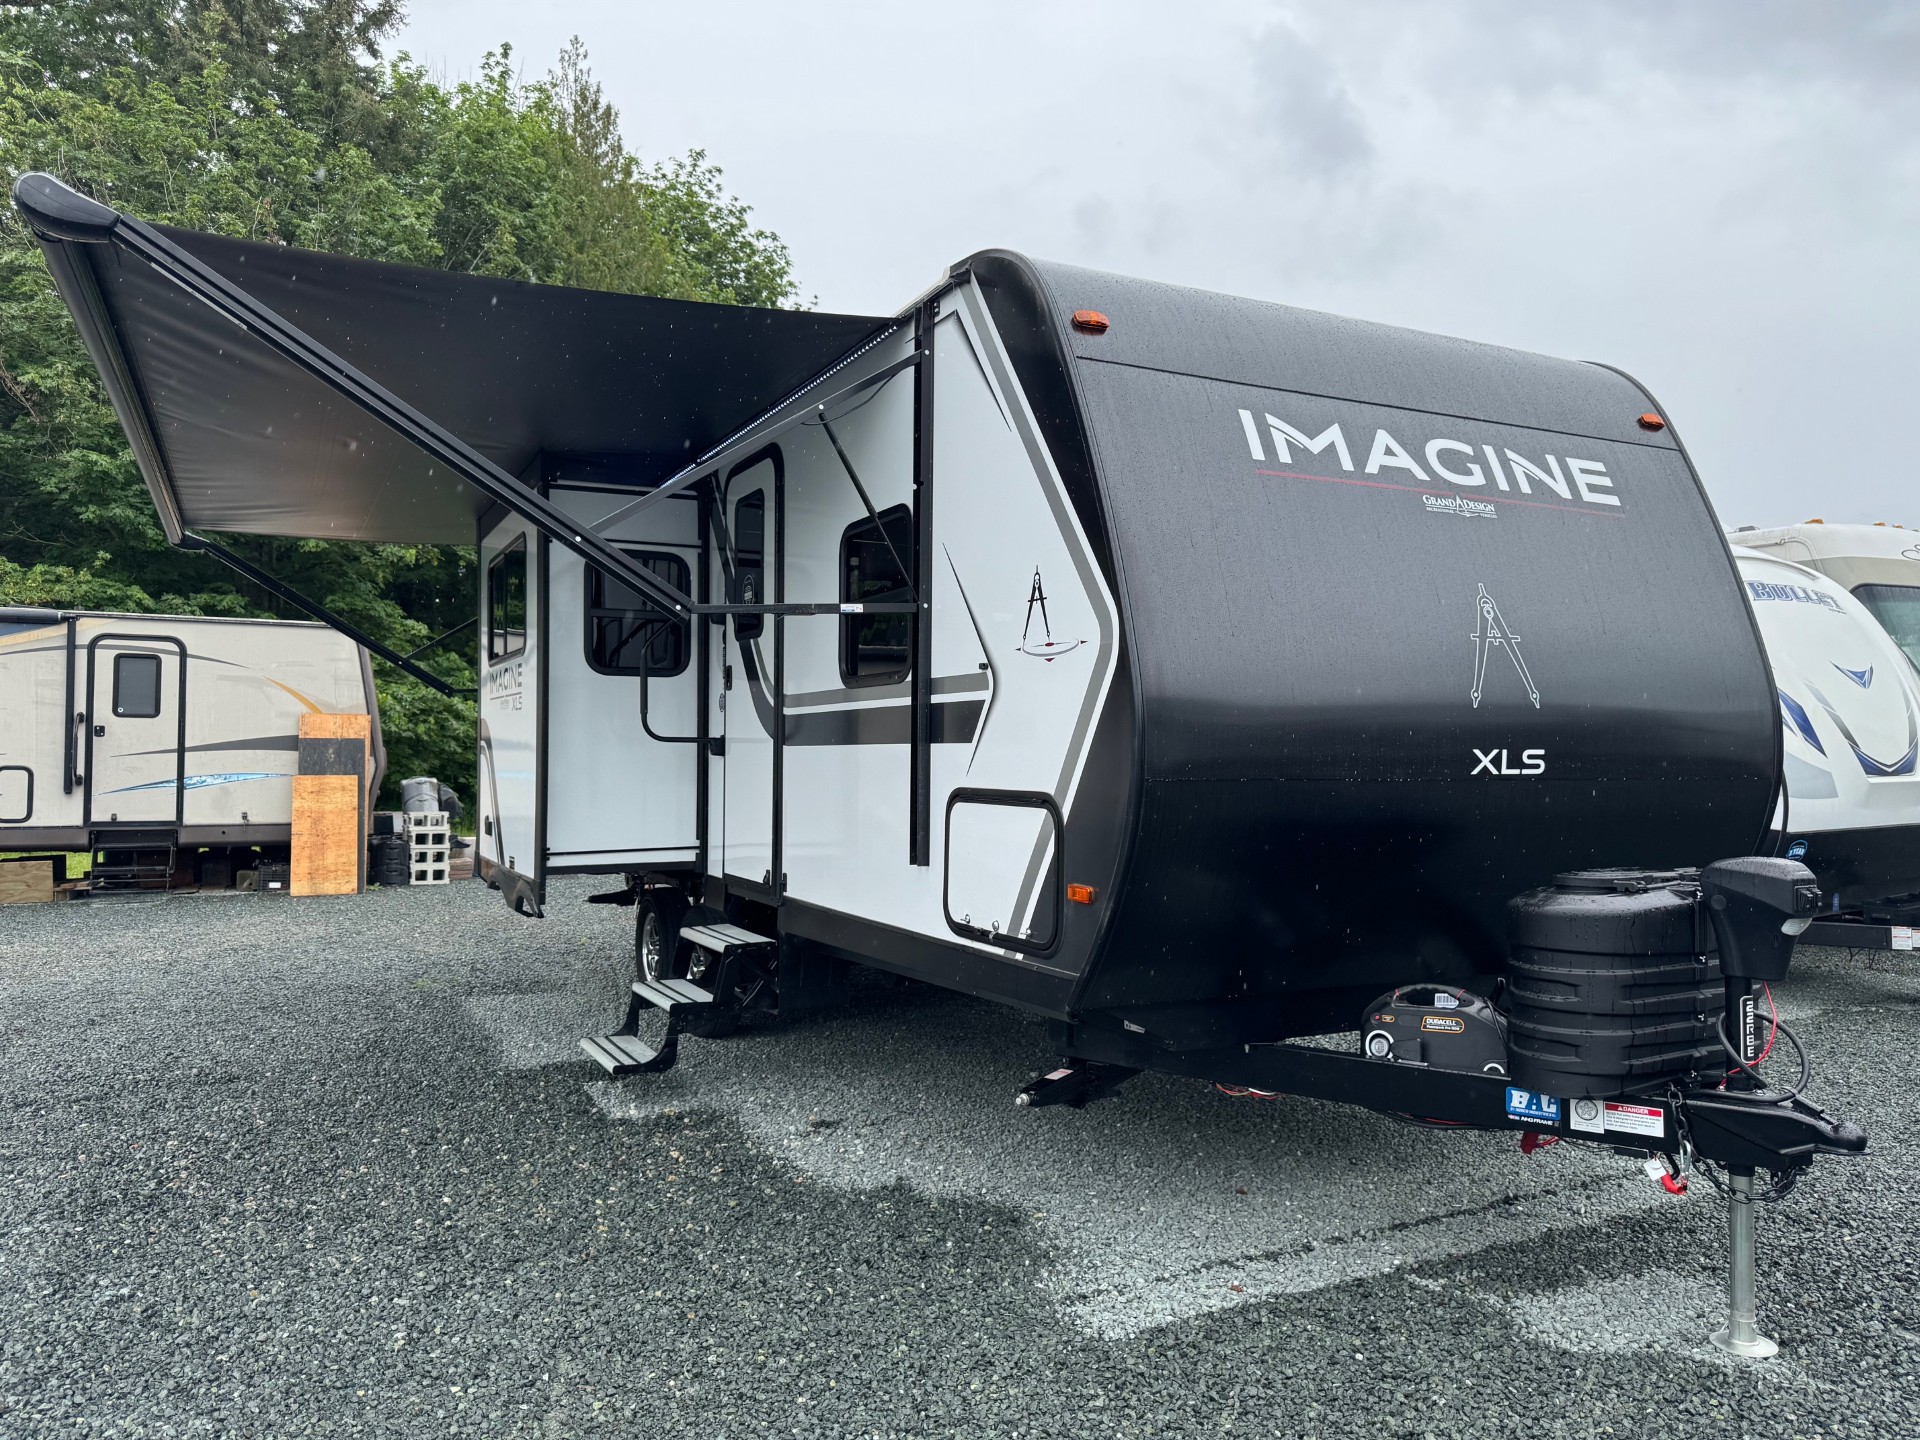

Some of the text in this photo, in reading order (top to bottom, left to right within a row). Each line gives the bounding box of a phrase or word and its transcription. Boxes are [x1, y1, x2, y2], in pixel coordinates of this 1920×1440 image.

[1238, 409, 1621, 506] IMAGINE
[1422, 494, 1496, 512] GRAND DESIGN
[1744, 580, 1844, 611] BULLET
[489, 663, 523, 695] IMAGINE
[511, 695, 523, 711] XLS
[1470, 748, 1546, 775] XLS
[1426, 1018, 1457, 1026] DURACELL
[1746, 1000, 1755, 1057] 22RBE
[1511, 1090, 1557, 1113] BAL
[1622, 1106, 1649, 1115] DANGER
